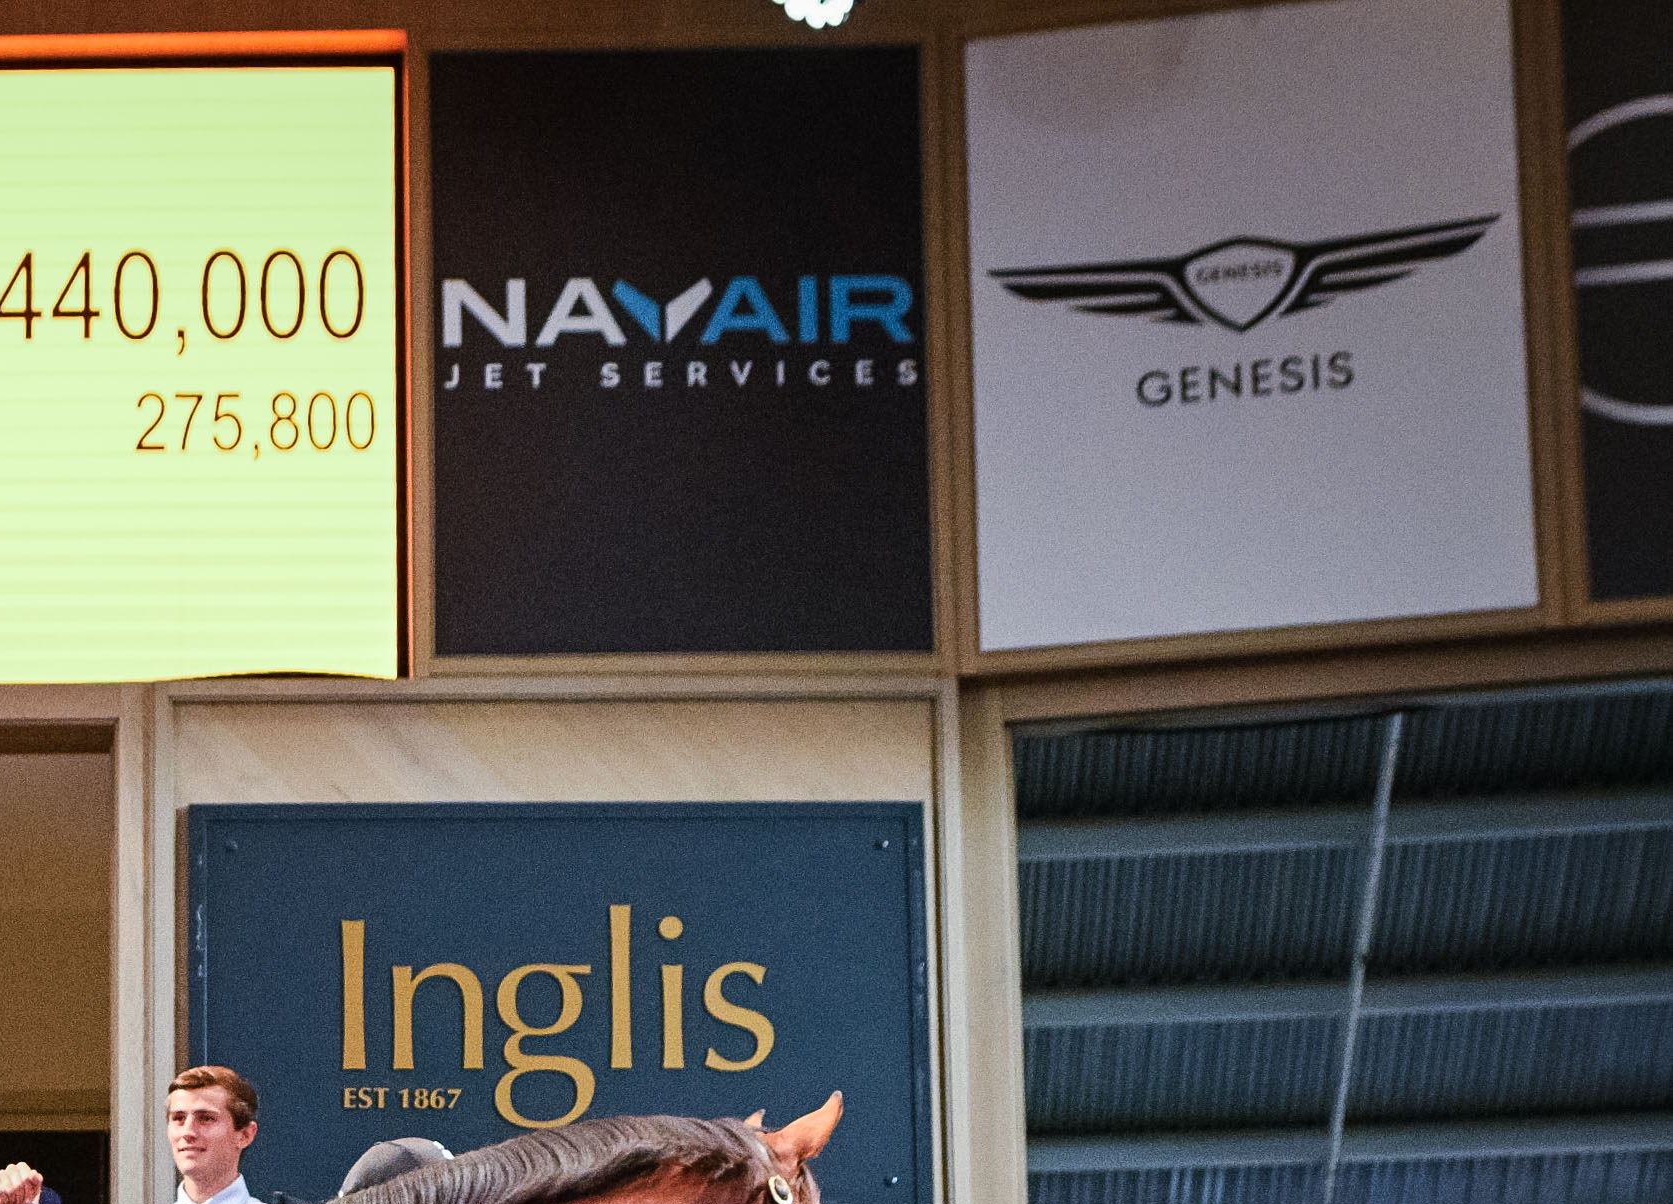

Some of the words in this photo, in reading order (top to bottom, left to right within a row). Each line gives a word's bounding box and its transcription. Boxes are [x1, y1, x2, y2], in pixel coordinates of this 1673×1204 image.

[441, 276, 912, 348] NAVAIR
[444, 362, 546, 390] JET
[600, 359, 918, 389] SERVICES
[1135, 351, 1356, 408] GENESIS
[135, 392, 376, 462] 275,800
[340, 904, 776, 1129] Inglis
[343, 1086, 388, 1110] EST
[399, 1087, 463, 1111] 1867
